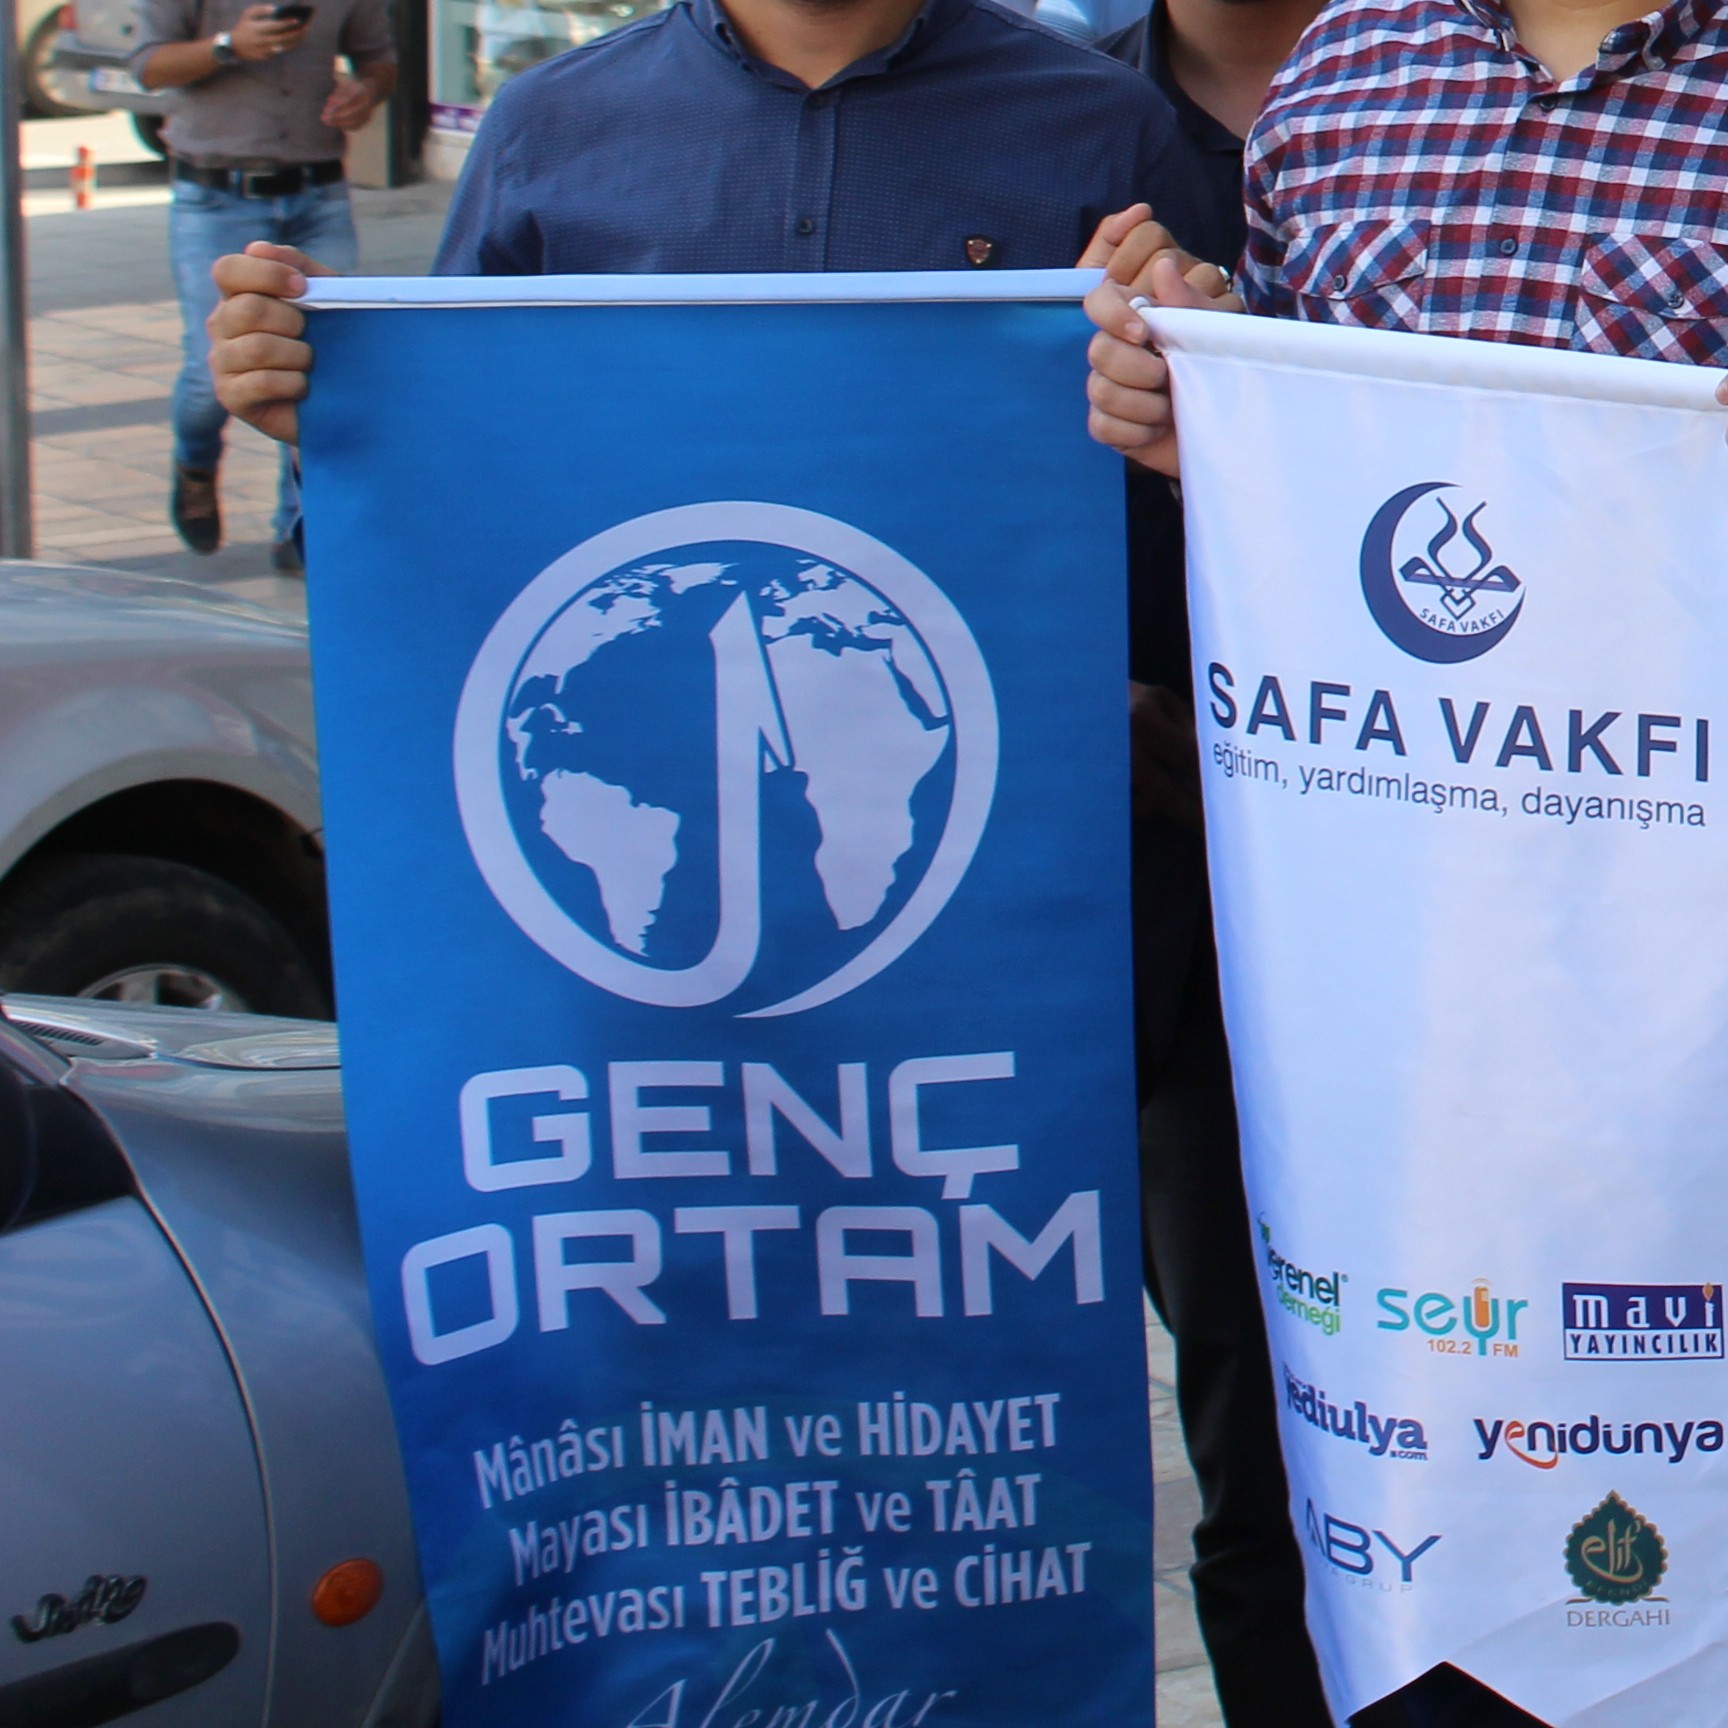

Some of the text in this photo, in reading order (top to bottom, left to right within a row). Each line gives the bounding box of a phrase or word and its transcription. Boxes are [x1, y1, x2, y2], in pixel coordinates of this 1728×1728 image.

[1418, 606, 1505, 634] SAFA VAKFI
[1208, 660, 1710, 783] SAFA VAKFI
[1212, 741, 1707, 830] eğitim, yardımlaşma, dayanışma
[459, 1051, 1020, 1200] GENÇ
[400, 1189, 1108, 1367] ORTAM
[1572, 1282, 1717, 1329] mavi
[1426, 1339, 1519, 1358] 102.2 FM
[1569, 1331, 1719, 1355] YAYINCILIK
[473, 1390, 1061, 1510] Mânâsı İMAN ve HİDAYET
[1474, 1414, 1724, 1470] yenidünya
[509, 1467, 1042, 1587] Mayası İBÂDET ve TÂAT
[1580, 1518, 1644, 1584] elif
[481, 1541, 1093, 1686] Muhtevası TEBLİĞ ve CİHAT
[1567, 1610, 1671, 1628] DERGAHI
